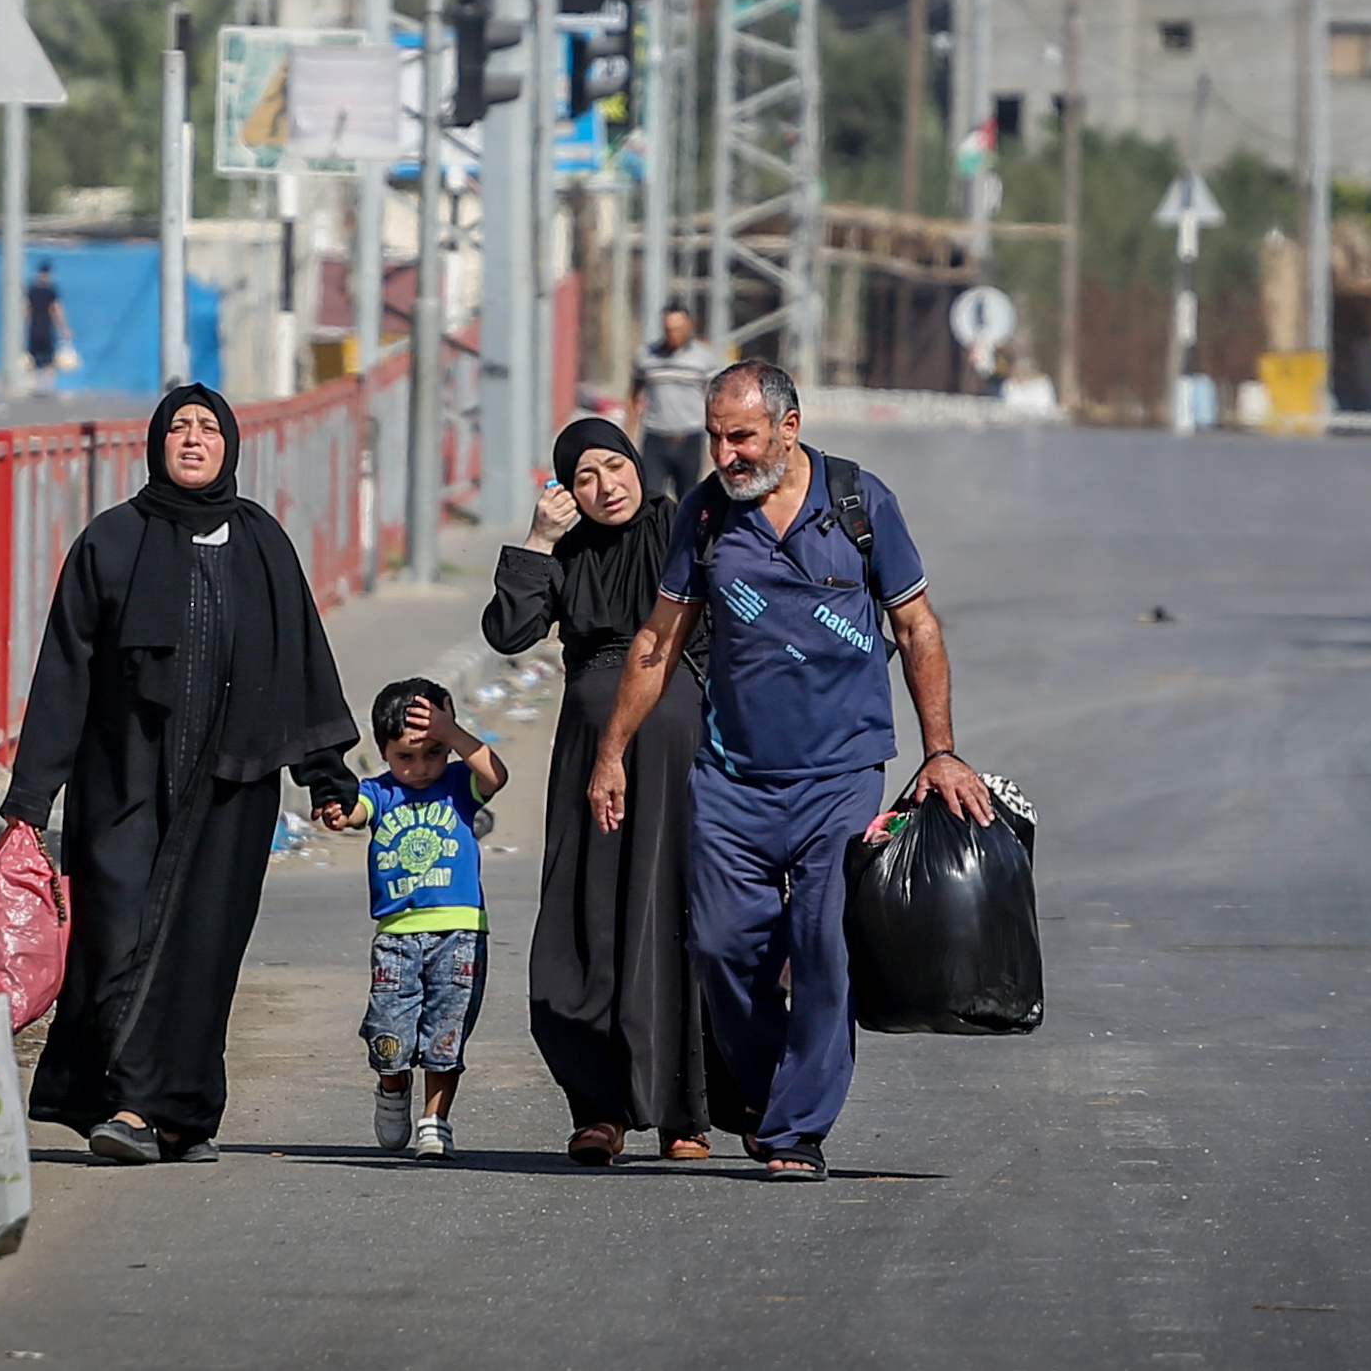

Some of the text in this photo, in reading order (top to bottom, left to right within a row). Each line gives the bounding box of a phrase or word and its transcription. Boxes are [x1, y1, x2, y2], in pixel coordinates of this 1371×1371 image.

[813, 604, 875, 654] national
[785, 644, 808, 663] SPORT
[377, 851, 398, 870] 20
